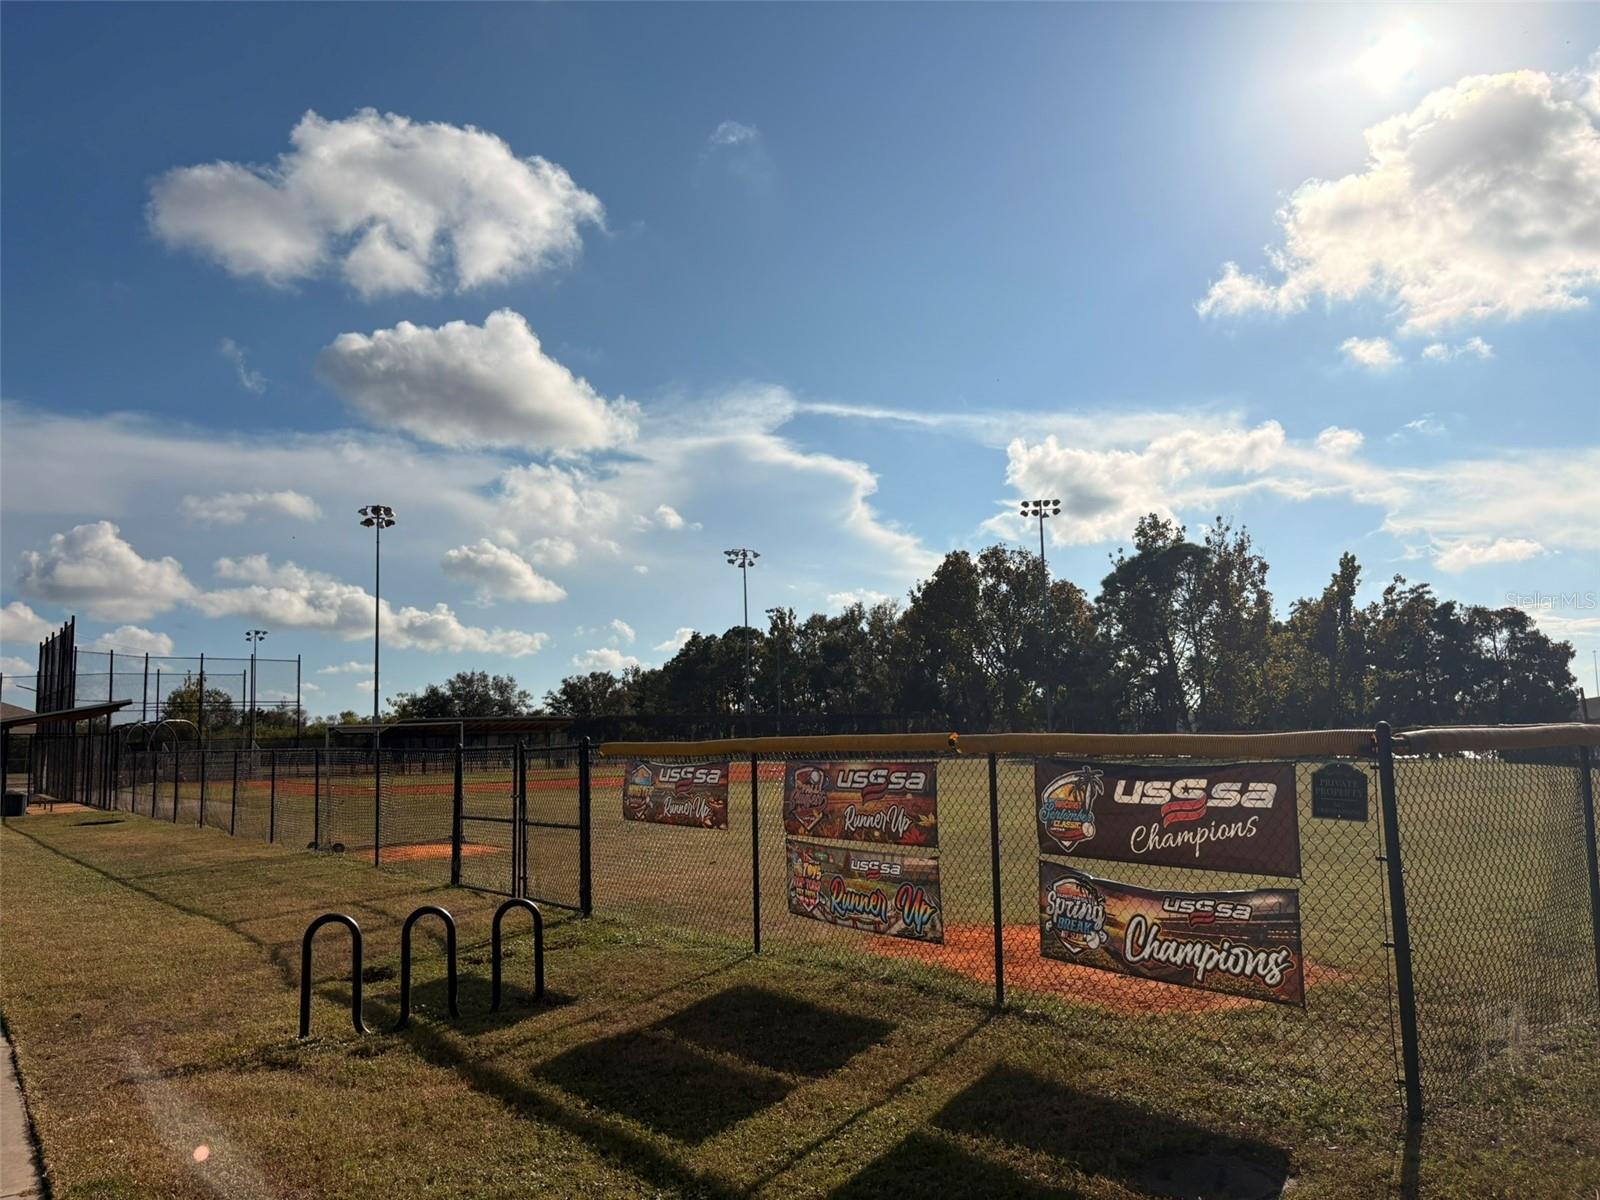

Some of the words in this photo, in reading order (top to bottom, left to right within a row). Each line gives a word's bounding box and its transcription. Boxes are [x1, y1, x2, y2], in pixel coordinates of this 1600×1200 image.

[663, 796, 692, 818] Runner
[692, 796, 710, 821] Up
[844, 805, 886, 832] Runner
[886, 805, 912, 837] Up
[1130, 815, 1260, 858] Champions
[830, 875, 889, 924] Runner
[894, 882, 937, 935] Up
[1046, 891, 1106, 931] Spring
[1057, 916, 1093, 935] BREAK
[1126, 914, 1294, 986] Champions
